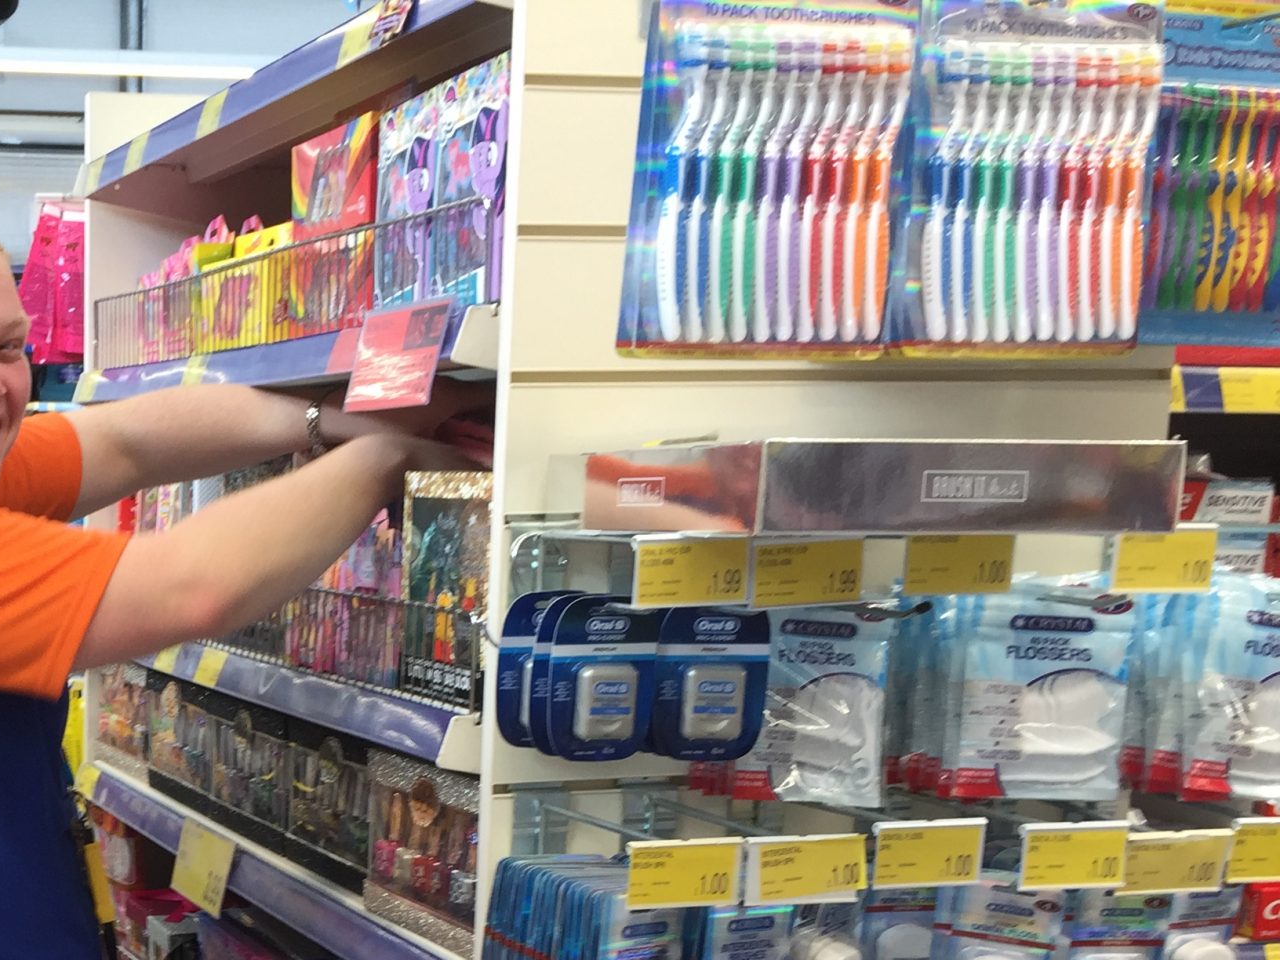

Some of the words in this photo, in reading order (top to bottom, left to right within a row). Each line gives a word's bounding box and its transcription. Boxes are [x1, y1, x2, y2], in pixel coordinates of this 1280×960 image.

[722, 4, 759, 19] PACK
[589, 619, 625, 631] Oral-B
[697, 619, 734, 631] Oral-B
[1006, 645, 1093, 662] FLOSSERS
[595, 682, 628, 693] Oral-B
[700, 682, 736, 693] Oral-B
